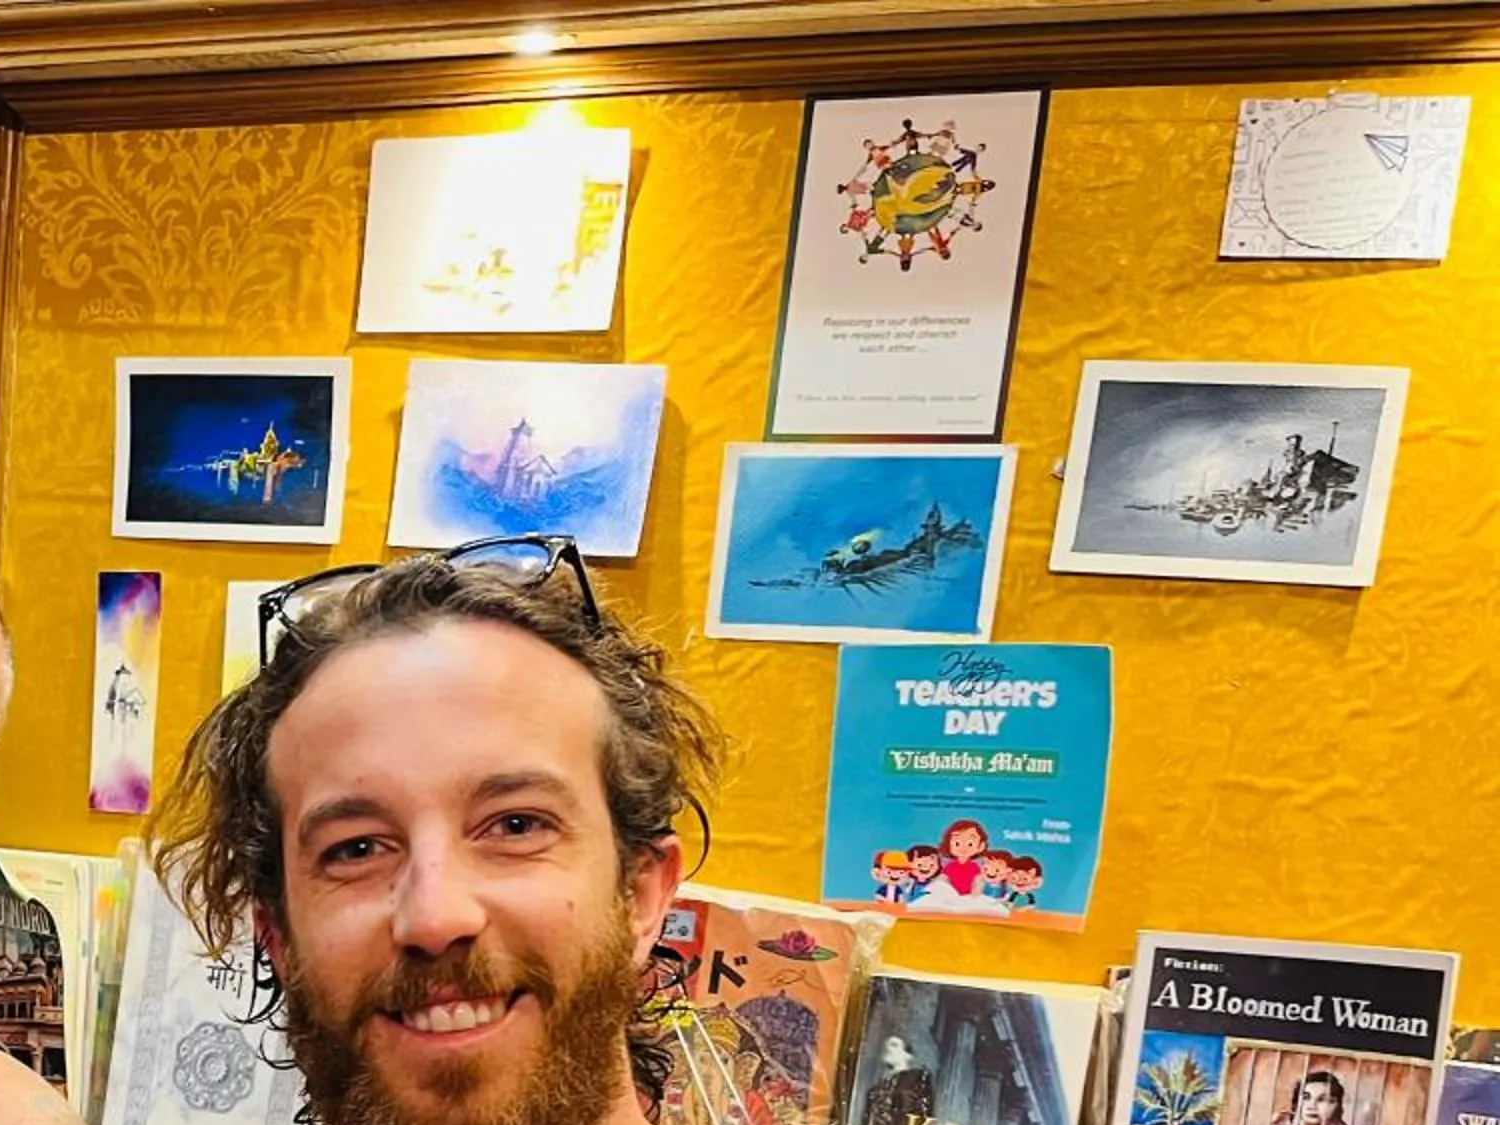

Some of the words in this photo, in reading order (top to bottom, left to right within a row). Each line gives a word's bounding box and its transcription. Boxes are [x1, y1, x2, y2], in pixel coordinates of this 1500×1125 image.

[944, 709, 1008, 736] DAY
[889, 750, 983, 772] Vishakha
[986, 751, 1053, 774] Ma'am
[7, 897, 52, 935] NORD
[1151, 979, 1180, 1009] A
[1187, 983, 1324, 1024] Bloomed
[1331, 996, 1429, 1038] Woman
